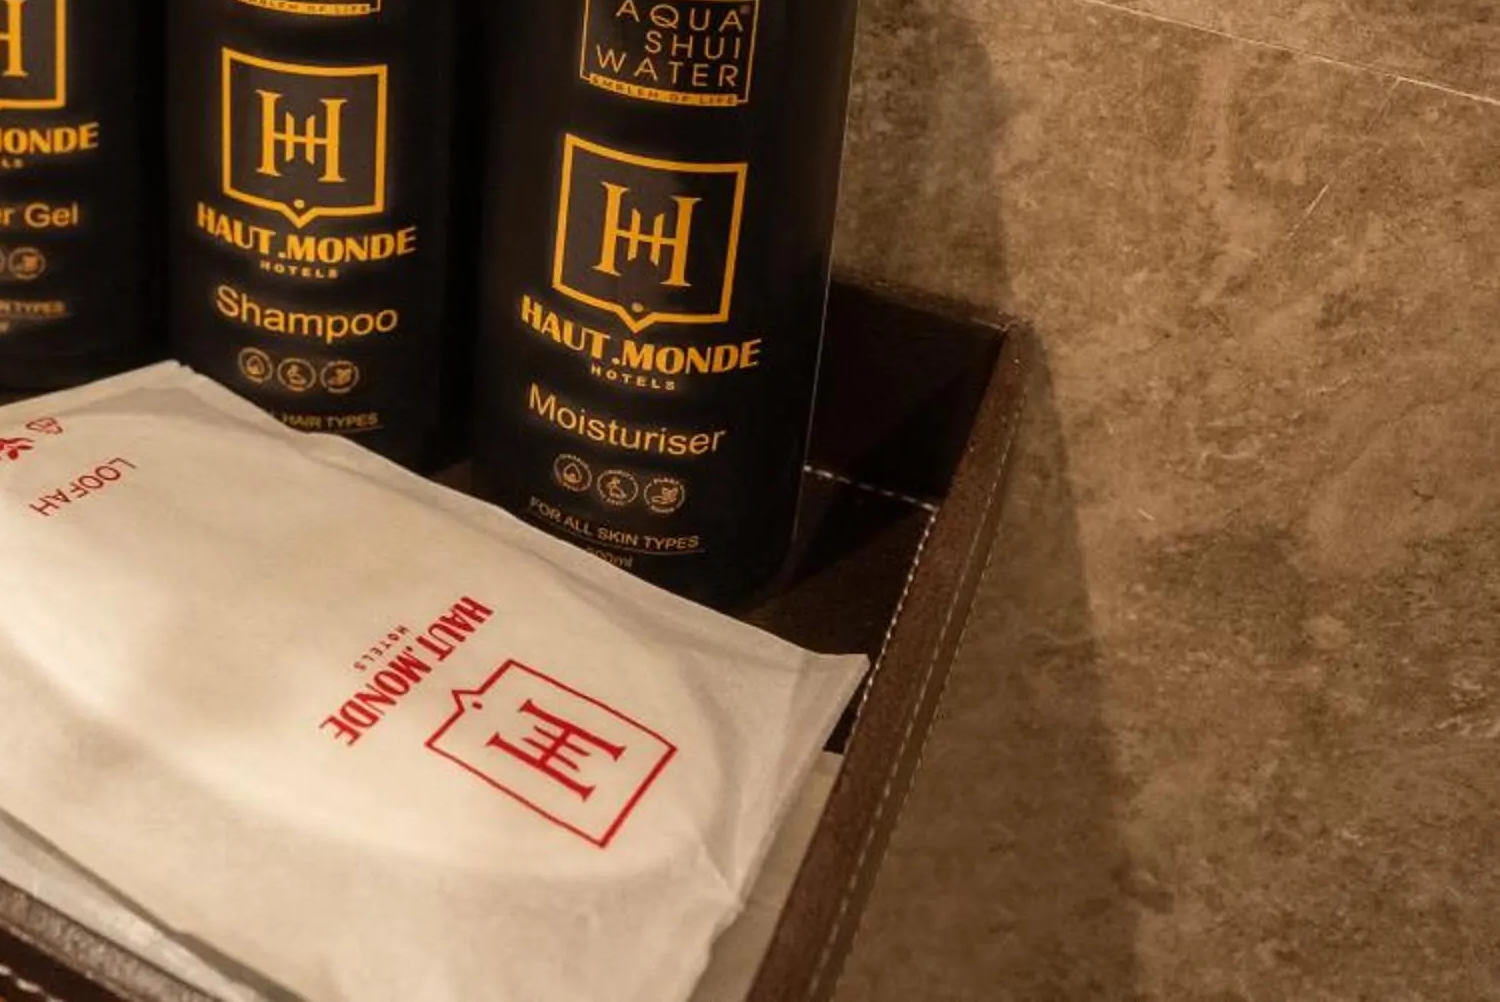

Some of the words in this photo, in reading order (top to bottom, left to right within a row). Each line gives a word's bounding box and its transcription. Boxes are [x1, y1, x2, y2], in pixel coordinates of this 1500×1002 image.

[645, 30, 741, 60] SHUI
[596, 44, 739, 87] WATER
[24, 202, 80, 228] Gel
[260, 260, 339, 279] HOTELS
[216, 285, 398, 344] Shampoo
[590, 363, 676, 391] HOTELS
[282, 413, 321, 429] HAIR
[327, 412, 379, 429] TYPES
[528, 382, 727, 455] Moisturiser
[29, 457, 137, 516] LOOFAH
[529, 496, 561, 523] FOR
[563, 515, 593, 537] ALL
[596, 526, 639, 547] SKIN
[643, 535, 699, 550] TYPES
[587, 548, 634, 569] 00ml
[353, 625, 410, 672] HOTELS
